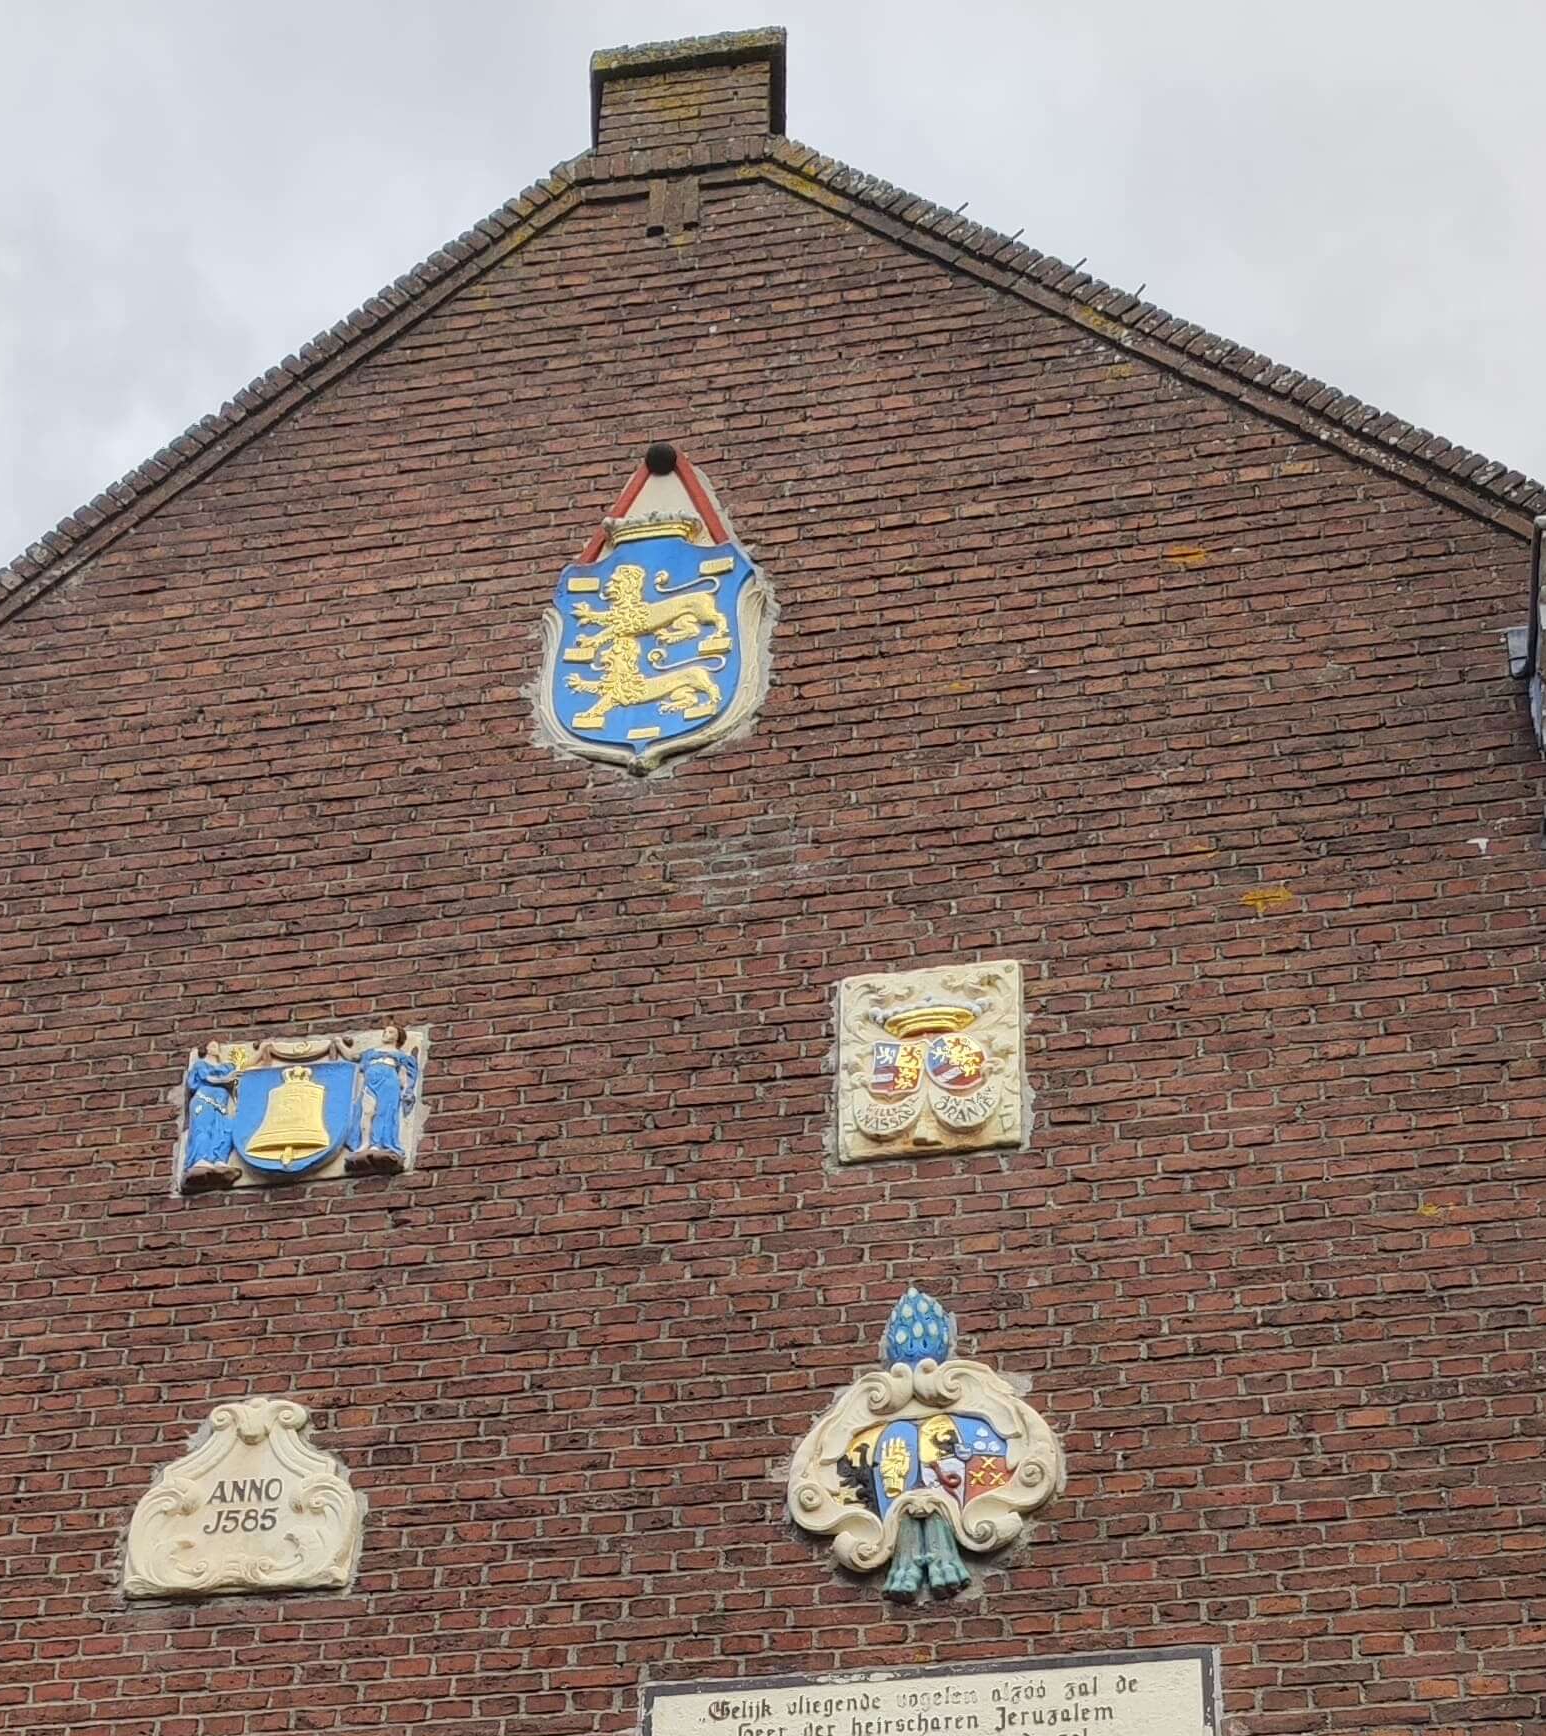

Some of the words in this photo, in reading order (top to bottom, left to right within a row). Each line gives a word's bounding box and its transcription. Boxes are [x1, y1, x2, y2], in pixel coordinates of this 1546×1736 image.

[206, 1478, 283, 1505] ANNO
[786, 1694, 881, 1718] vliegende
[1064, 1676, 1098, 1700] zal
[1116, 1675, 1139, 1694] de
[995, 1703, 1114, 1732] Jeruzalem
